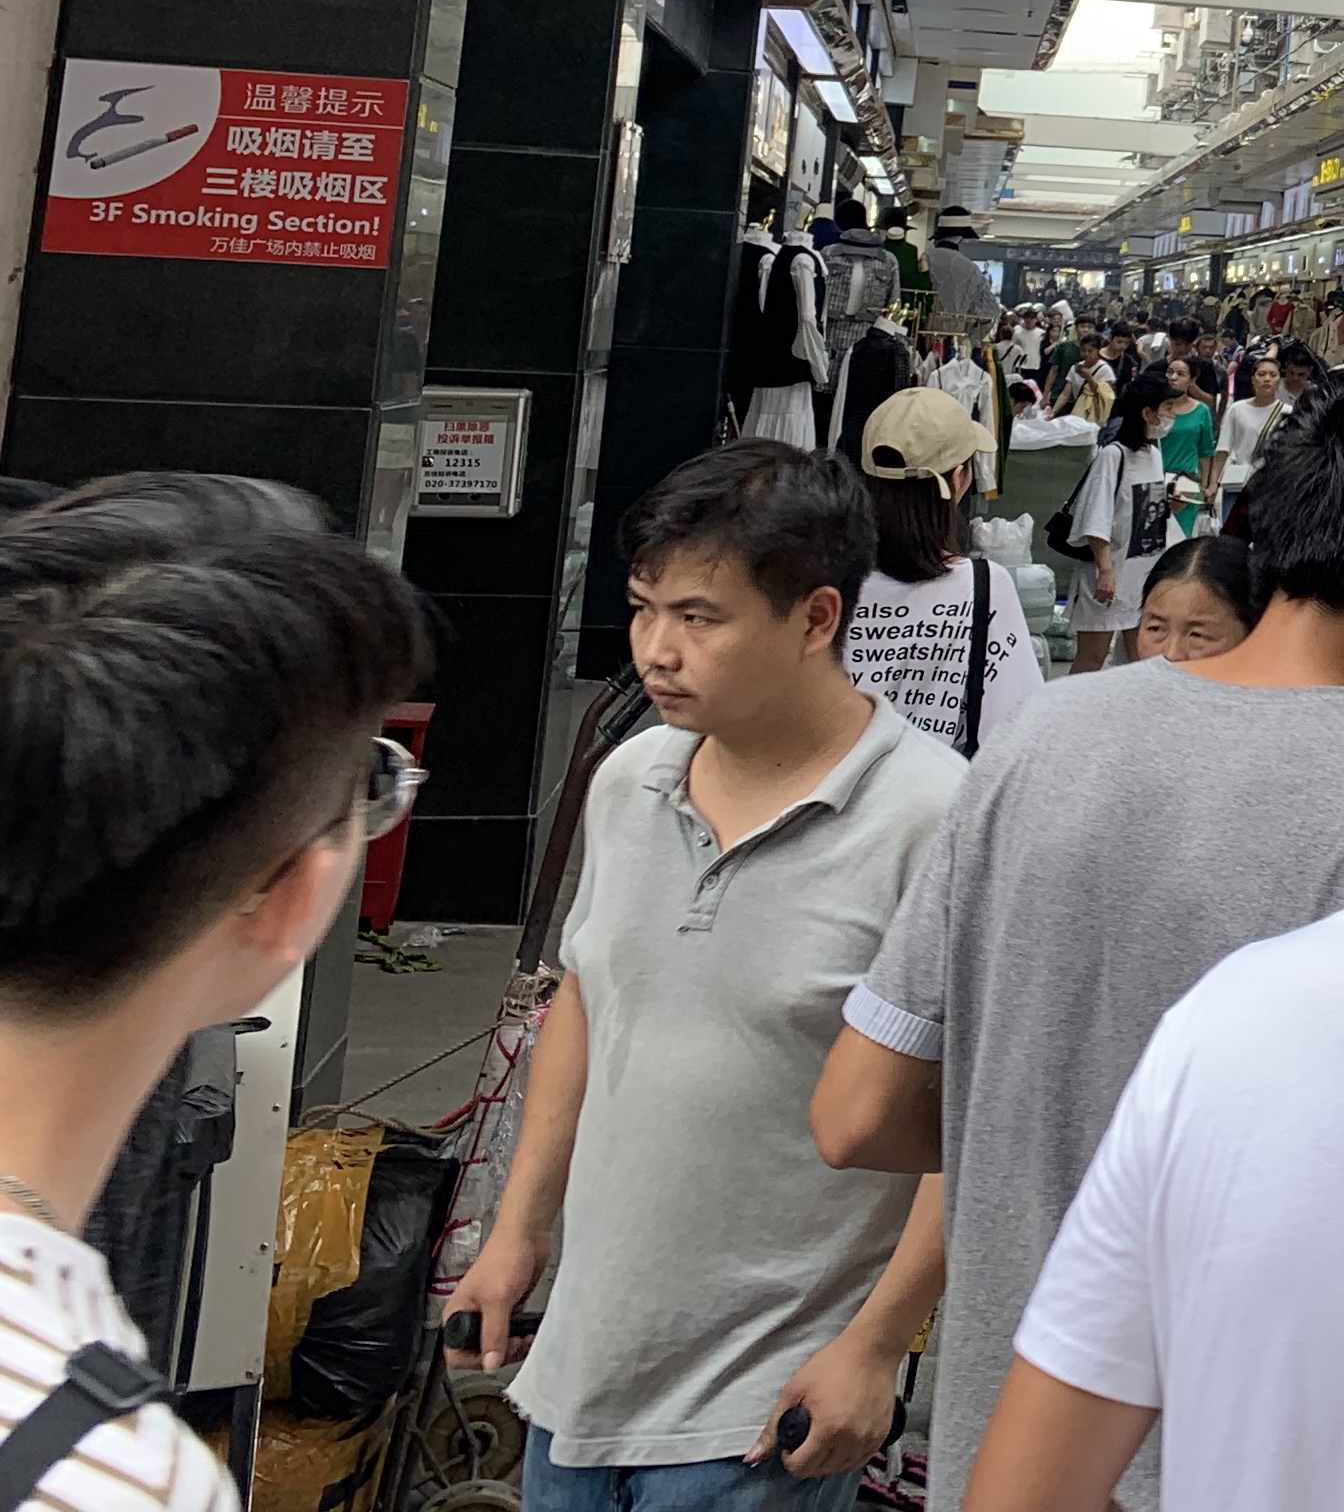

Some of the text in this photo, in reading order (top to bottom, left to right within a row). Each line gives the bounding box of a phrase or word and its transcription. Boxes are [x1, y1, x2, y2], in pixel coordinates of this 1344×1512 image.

[243, 82, 385, 118] 温馨提示
[227, 125, 376, 162] 吸烟请至
[201, 166, 389, 205] 三楼吸烟区
[89, 201, 381, 237] 3F Smoking Section!
[209, 236, 377, 261] 万佳广场内禁止吸烟
[445, 458, 481, 468] 12315
[855, 602, 910, 619] also
[851, 642, 966, 664] sweatshirt
[870, 666, 925, 683] ofern
[903, 688, 936, 706] the
